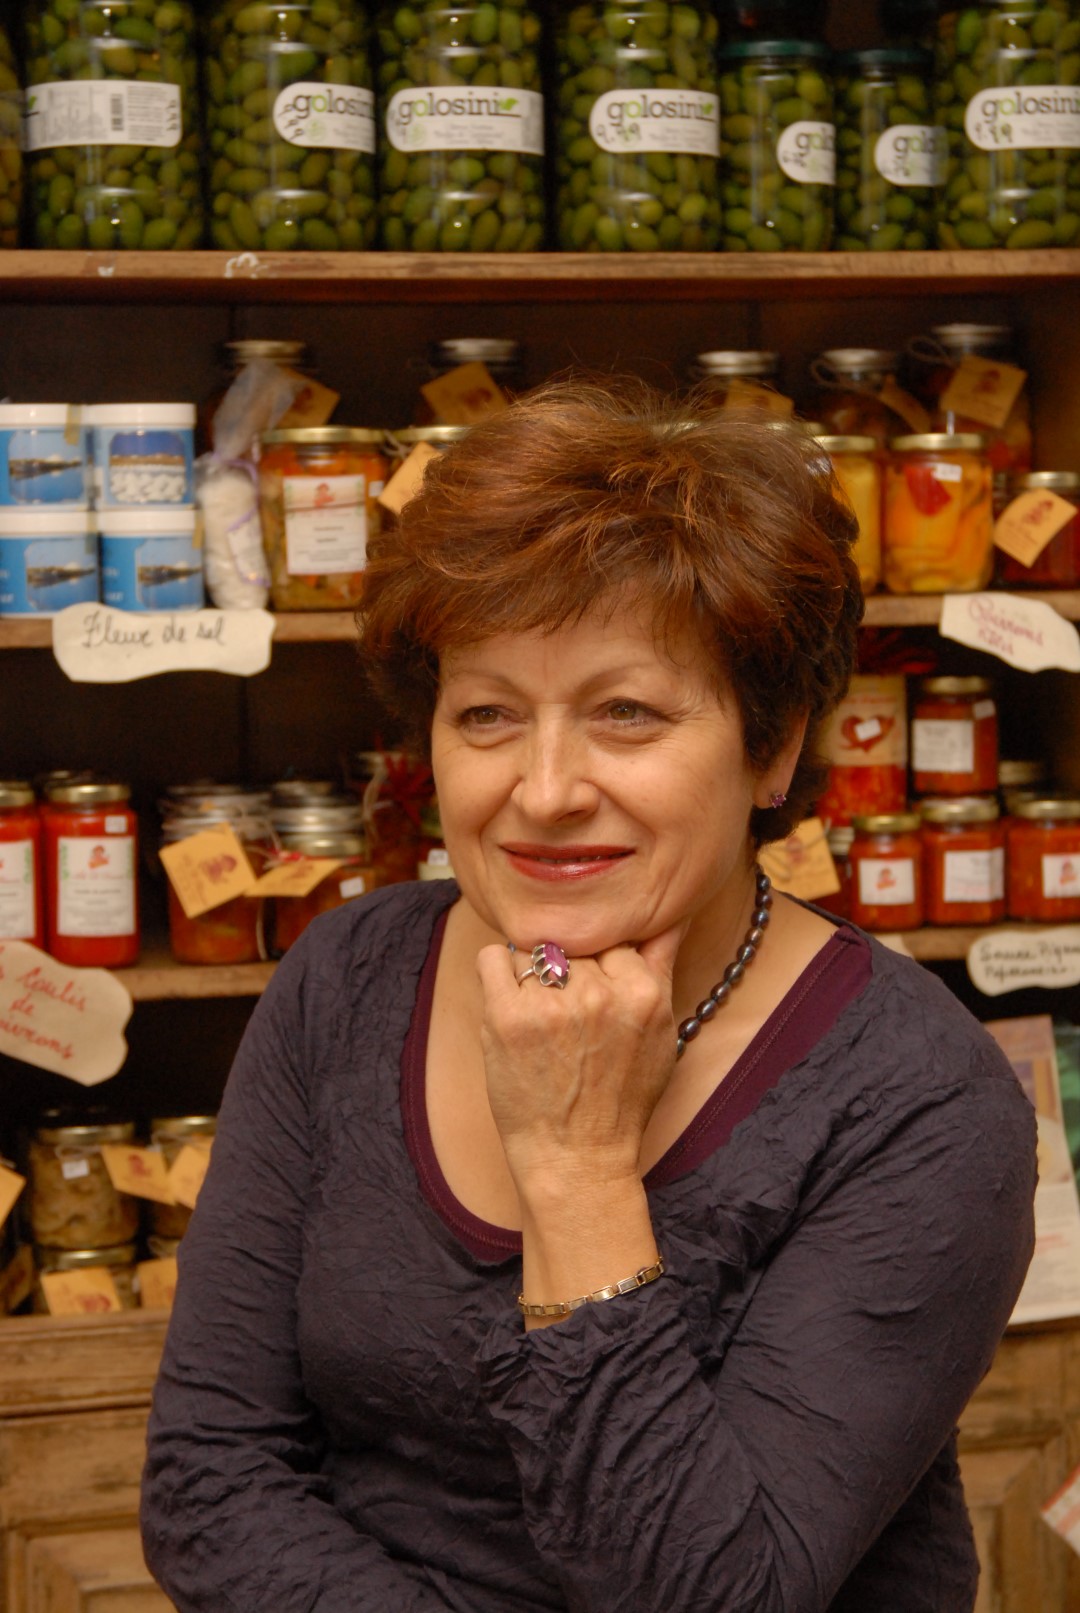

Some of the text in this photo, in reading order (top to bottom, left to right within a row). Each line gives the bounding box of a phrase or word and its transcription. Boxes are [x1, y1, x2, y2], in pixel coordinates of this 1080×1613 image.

[399, 92, 504, 125] golosini
[82, 611, 225, 648] Fleur de sel
[10, 991, 34, 1016] de
[16, 966, 86, 1012] Coulis
